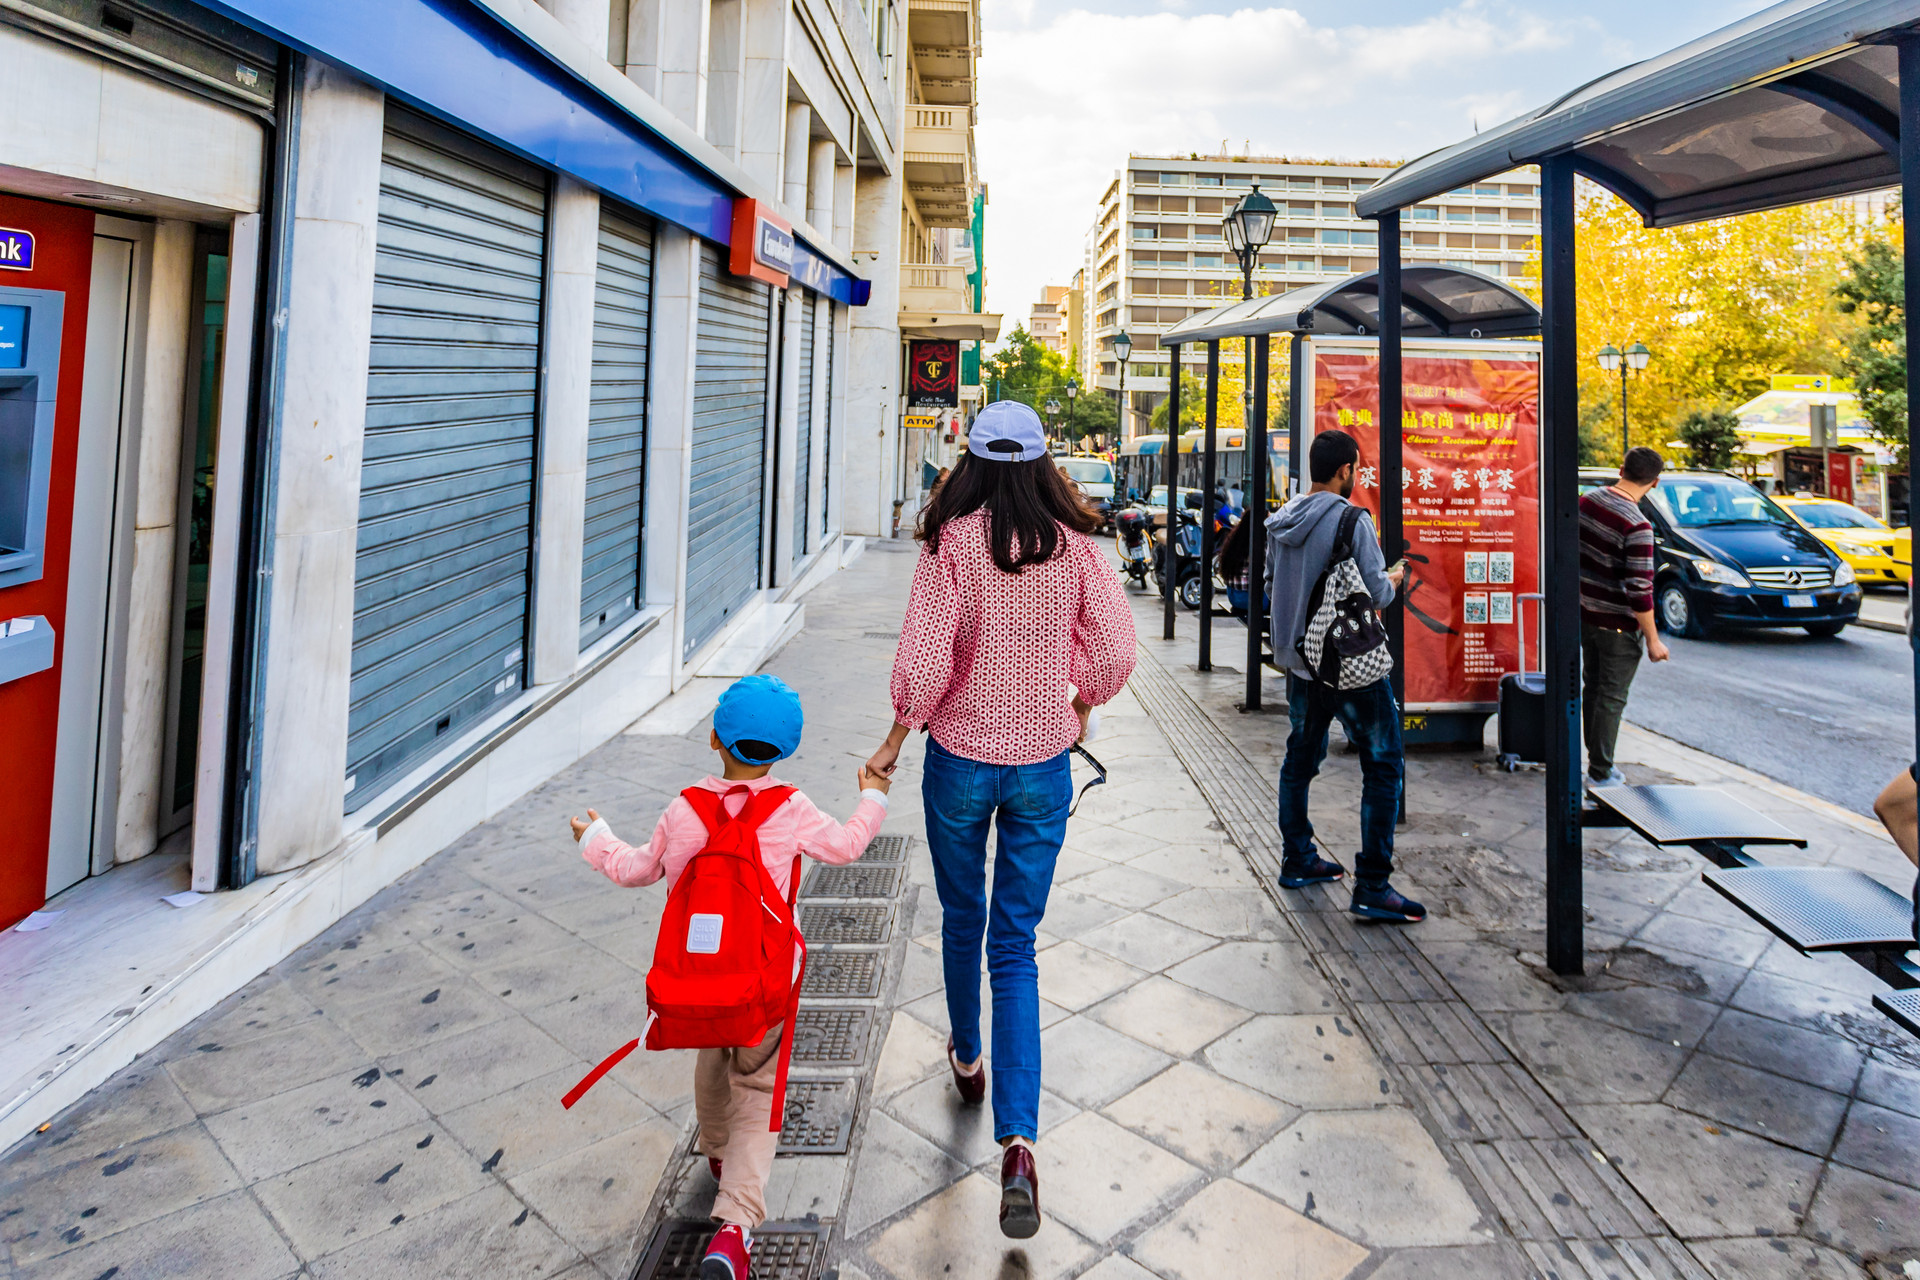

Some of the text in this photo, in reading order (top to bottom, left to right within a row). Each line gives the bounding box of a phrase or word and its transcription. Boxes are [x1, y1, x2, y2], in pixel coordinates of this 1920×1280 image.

[1464, 412, 1516, 430] 中餐厅
[1406, 435, 1439, 444] Chinese
[1442, 435, 1488, 446] Restaurant
[1451, 467, 1516, 491] 家常菜
[1419, 529, 1441, 537] Beijing
